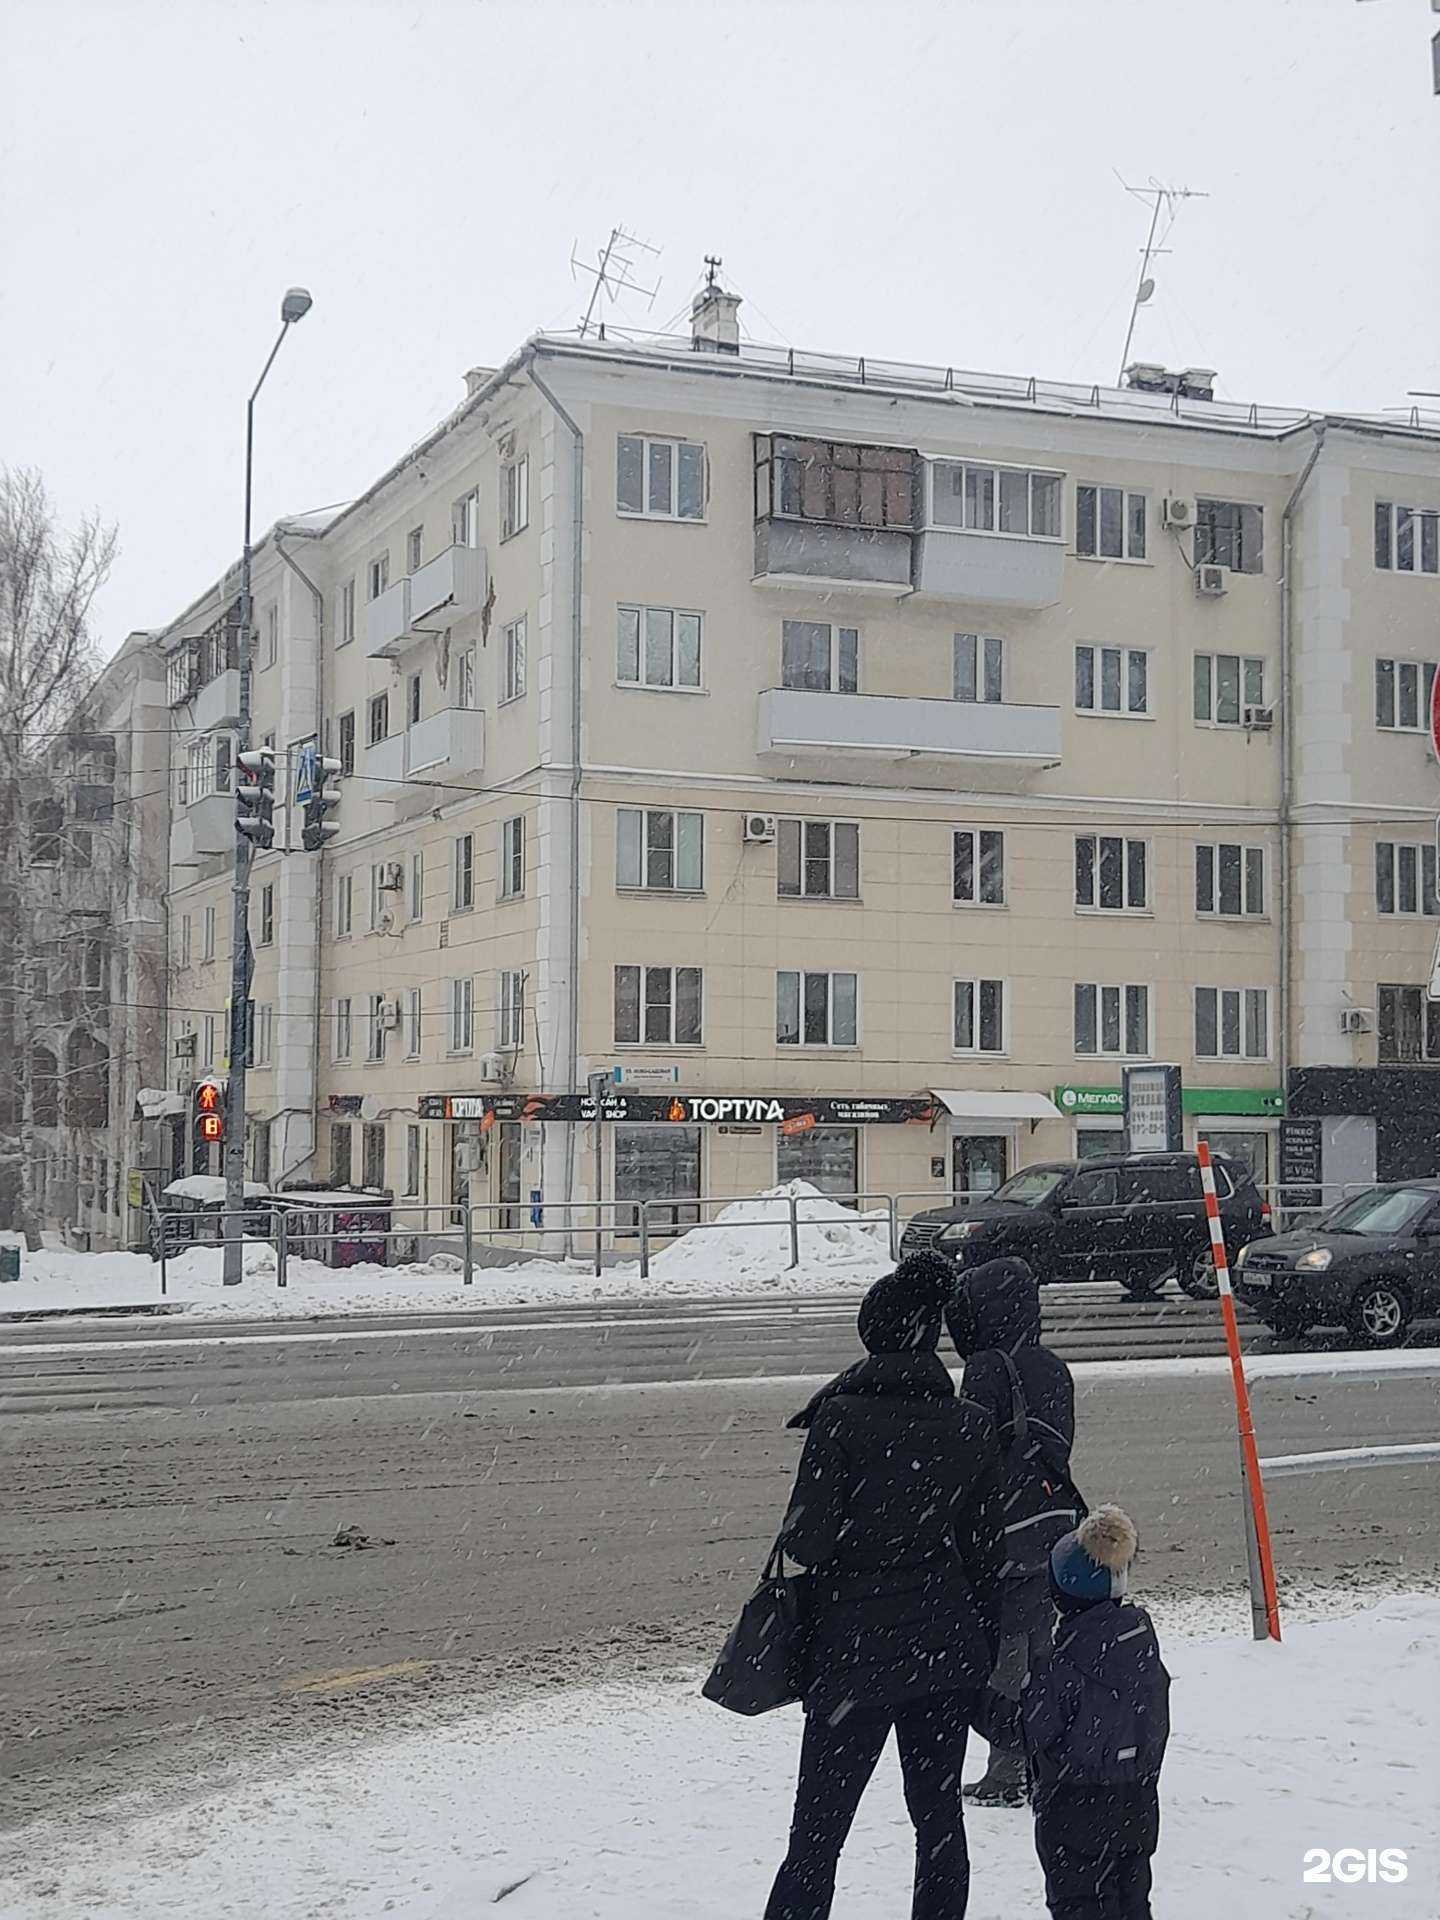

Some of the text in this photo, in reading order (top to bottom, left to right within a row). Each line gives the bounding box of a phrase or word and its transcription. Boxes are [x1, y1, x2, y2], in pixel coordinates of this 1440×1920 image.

[1078, 1092, 1123, 1104] МЕГАФ
[605, 1110, 627, 1119] SHOP
[688, 1098, 785, 1120] ТОРТУГА
